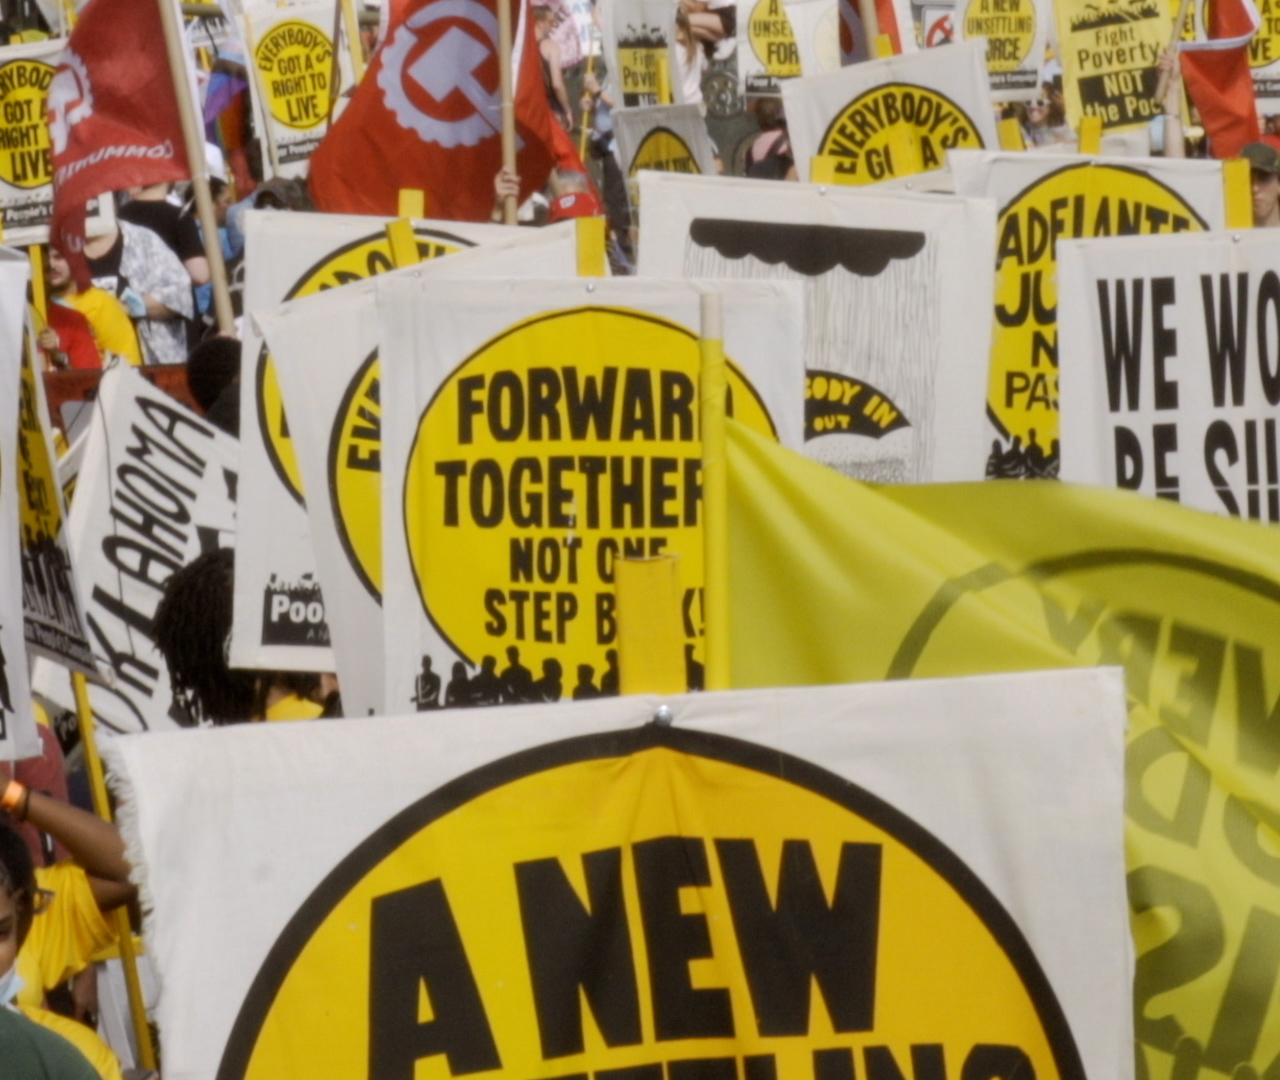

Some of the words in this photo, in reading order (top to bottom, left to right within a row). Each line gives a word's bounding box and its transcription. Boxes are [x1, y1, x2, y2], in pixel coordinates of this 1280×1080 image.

[967, 13, 1032, 33] UNSETTLING
[1095, 27, 1135, 46] Fight
[258, 27, 332, 72] EVERYBODY'S
[277, 53, 303, 76] GOT
[304, 54, 313, 71] A
[1077, 40, 1161, 70] Poverty
[272, 74, 308, 98] RIGHT
[312, 73, 327, 91] TO
[1104, 71, 1143, 96] NOT
[4, 100, 34, 124] GOT
[285, 96, 320, 123] LIVE
[829, 92, 968, 175] EVERYBODY'S
[921, 135, 939, 169] A
[1096, 276, 1180, 413] WE
[813, 414, 851, 431] OUT
[863, 395, 897, 429] IN
[88, 395, 216, 736] OKLAHOMA
[510, 537, 583, 585] NOT
[483, 588, 579, 644] STEP
[367, 878, 503, 1080] A
[513, 835, 884, 1062] NEW
